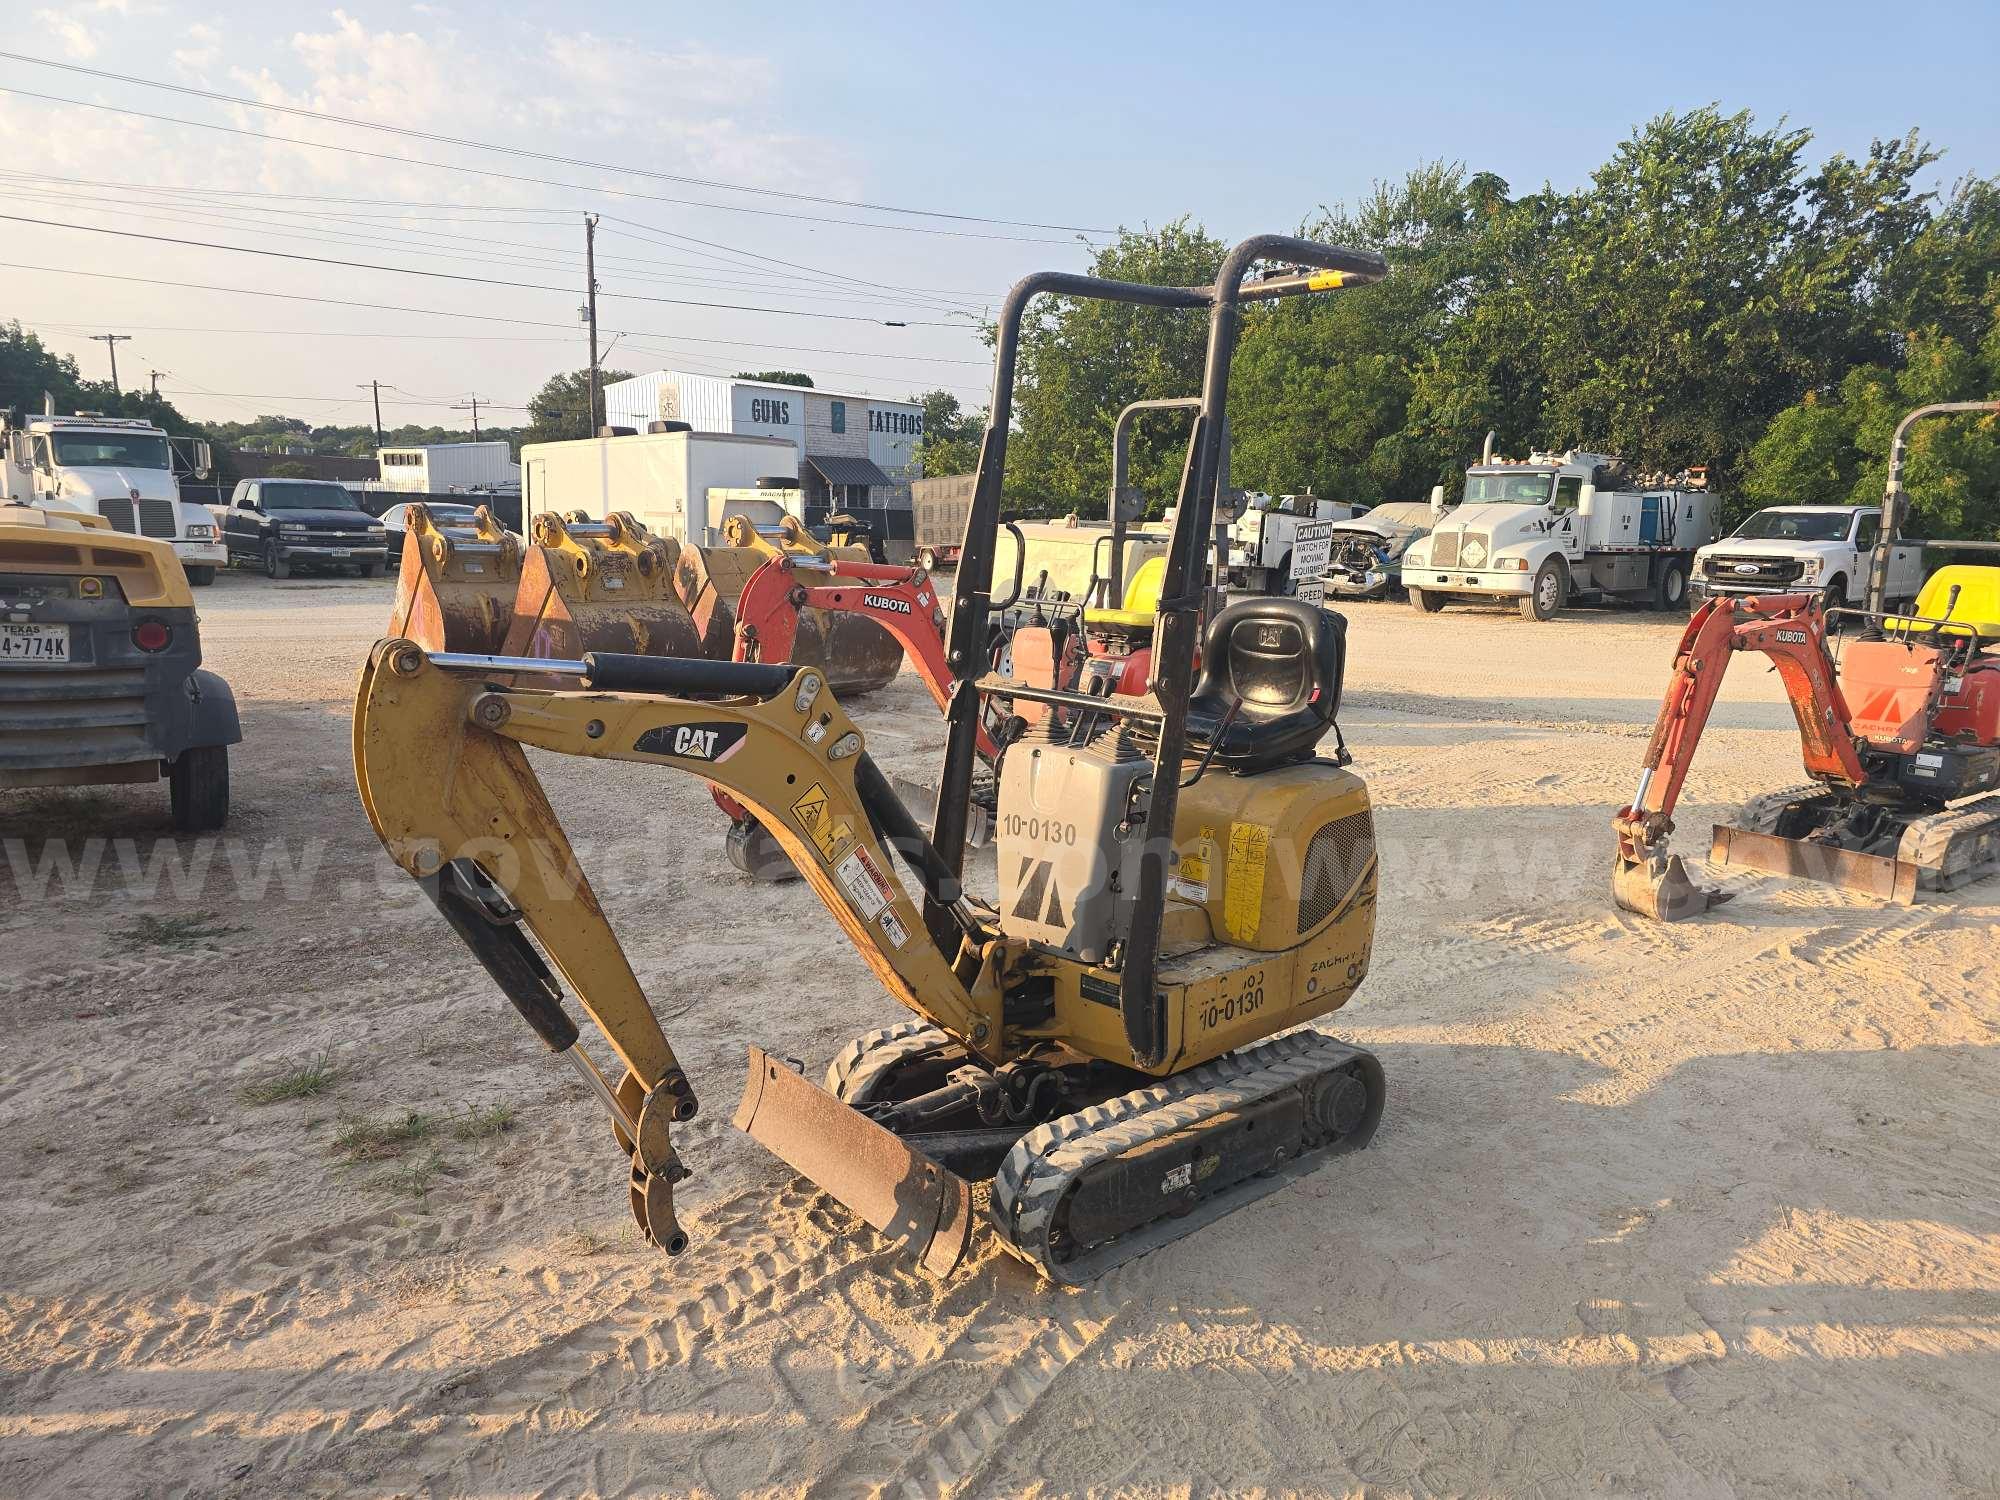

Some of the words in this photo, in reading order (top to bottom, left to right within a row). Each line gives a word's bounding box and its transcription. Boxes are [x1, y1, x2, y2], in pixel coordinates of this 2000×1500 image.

[752, 398, 790, 424] GUNS
[868, 410, 922, 435] TATTOOS
[1297, 525, 1331, 540] CAUTION
[1296, 543, 1318, 552] WATCH
[1319, 541, 1329, 550] FOR
[1301, 553, 1324, 564] MOVING
[1294, 564, 1327, 576] EQUIPMENT
[1298, 590, 1322, 602] SPEED
[864, 594, 911, 614] KUBOTA
[2, 625, 40, 633] TEXAS
[1776, 630, 1806, 645] KUBOTA
[674, 726, 719, 759] CAT
[1874, 735, 1907, 745] KUBOTA
[1003, 813, 1077, 846] 10-0130
[864, 860, 890, 895] WARNING
[1200, 987, 1264, 1031] 10-0130
